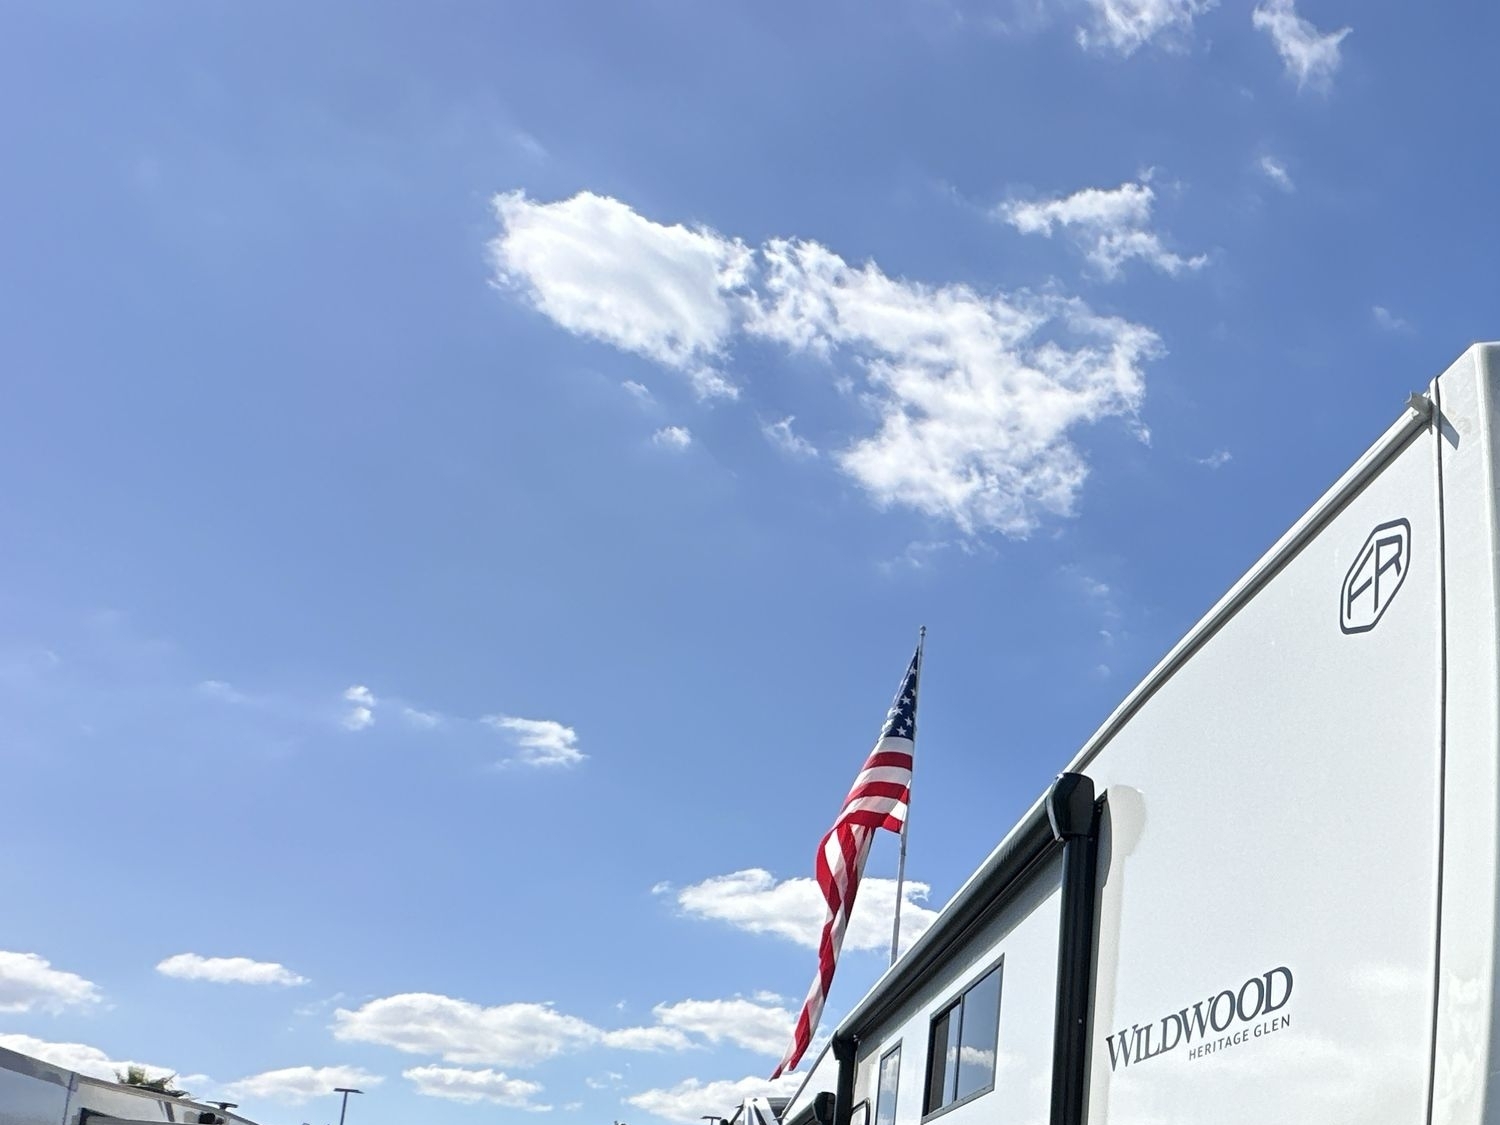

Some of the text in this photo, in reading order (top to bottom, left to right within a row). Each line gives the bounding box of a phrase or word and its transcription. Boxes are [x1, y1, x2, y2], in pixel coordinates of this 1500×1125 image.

[1105, 965, 1294, 1072] WILDWOOD
[1188, 1013, 1291, 1061] HERITAGE GLEN
